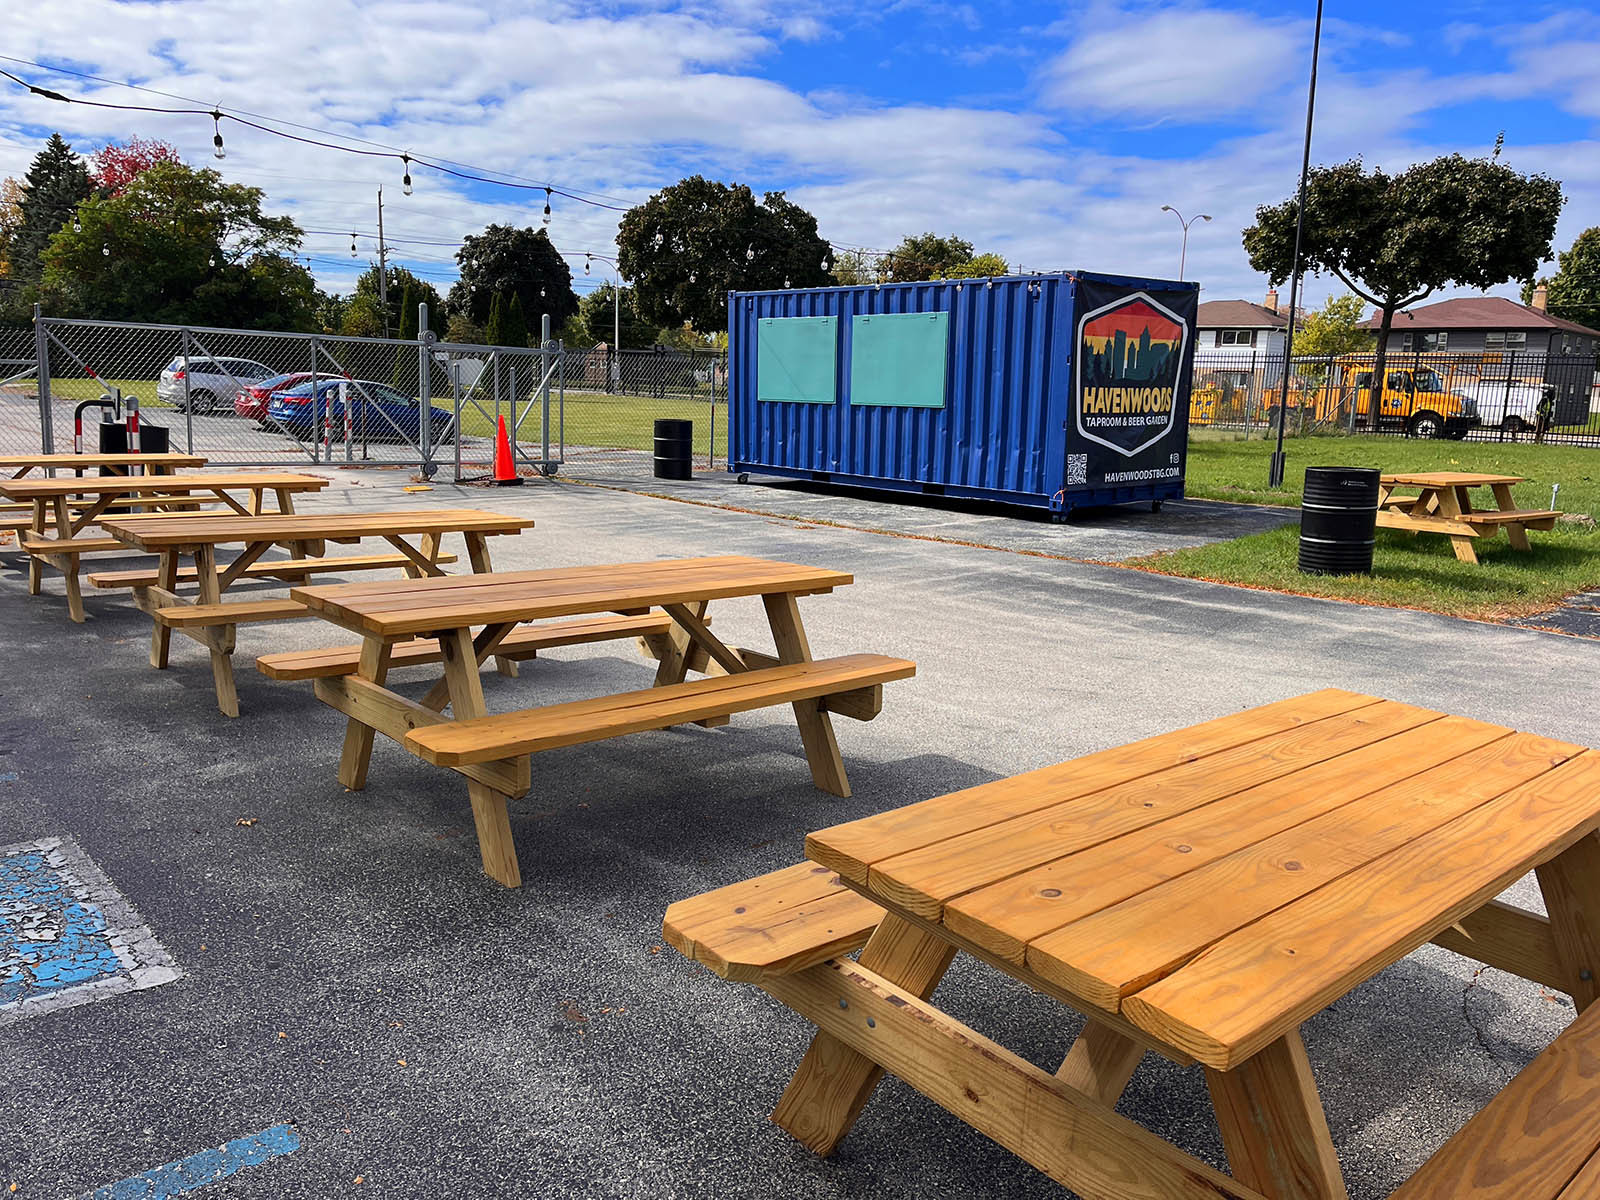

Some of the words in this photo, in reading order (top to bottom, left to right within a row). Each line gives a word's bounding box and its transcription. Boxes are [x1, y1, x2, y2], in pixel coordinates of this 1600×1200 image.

[1082, 386, 1172, 414] HAVENWOODS
[1086, 416, 1121, 427] TAPROOM
[1122, 417, 1128, 426] &
[1128, 416, 1145, 426] BEER
[1145, 415, 1168, 425] GARDEN
[1104, 467, 1180, 483] HAVENWOODSTBG.COM
